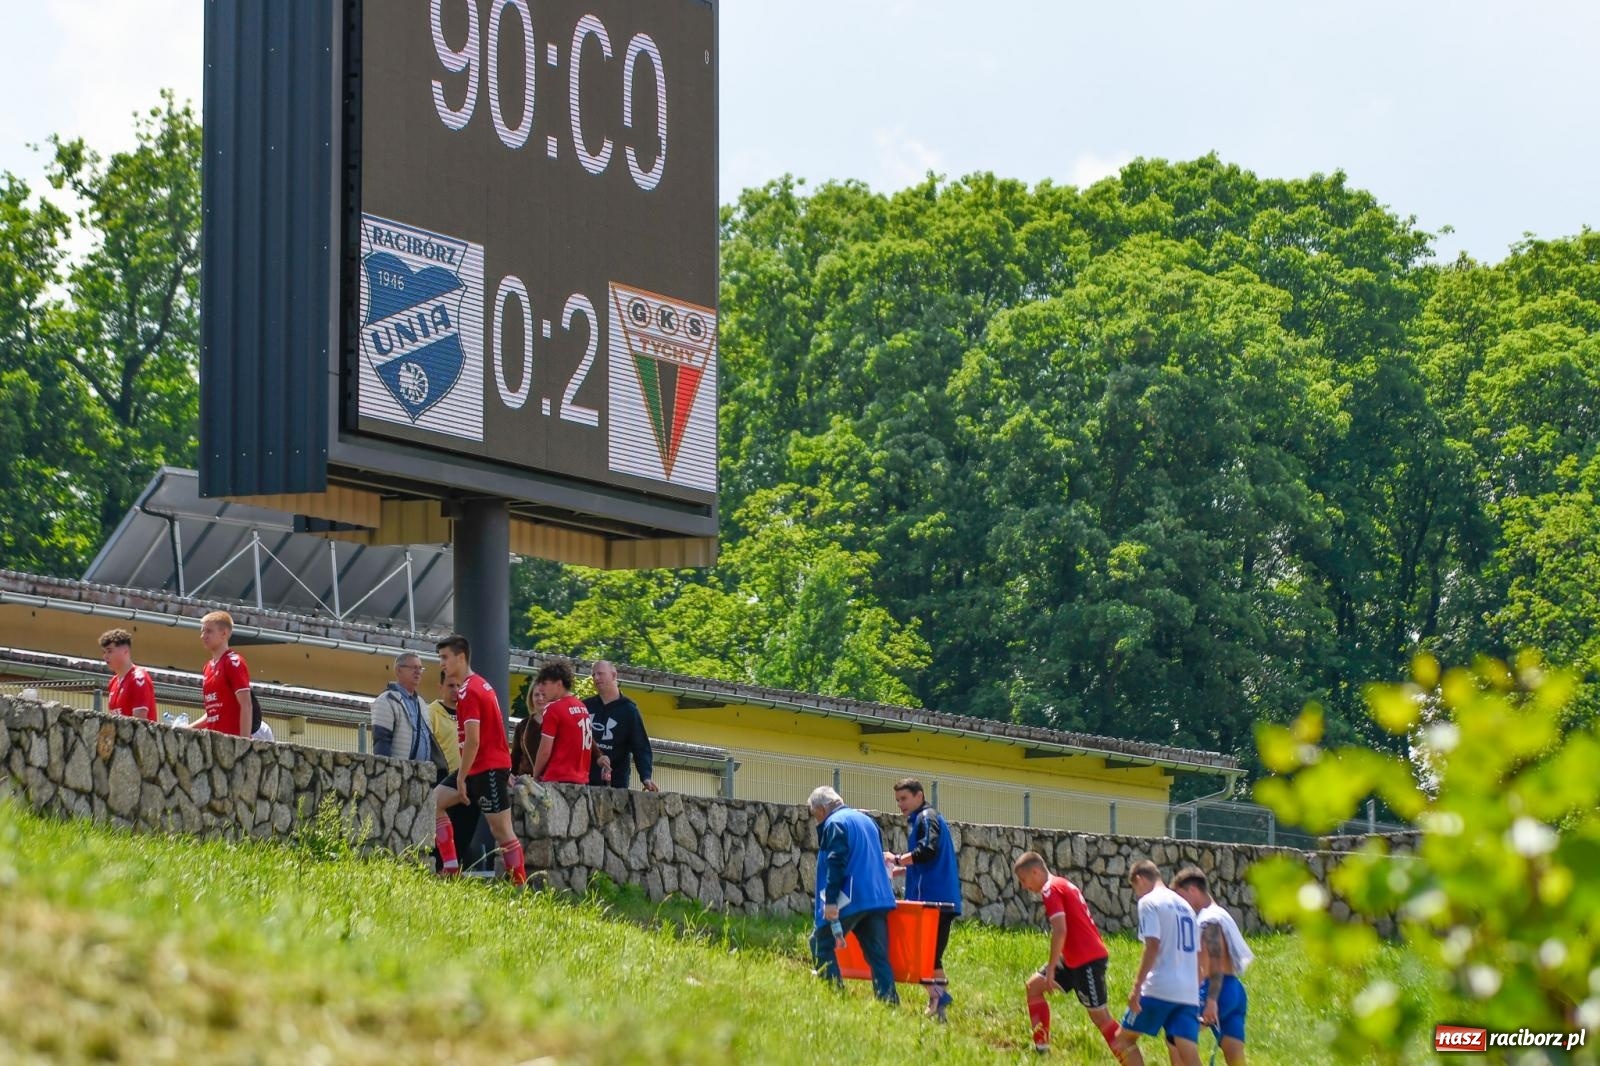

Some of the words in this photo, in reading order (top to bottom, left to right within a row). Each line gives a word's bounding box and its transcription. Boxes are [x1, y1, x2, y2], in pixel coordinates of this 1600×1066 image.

[372, 227, 457, 266] RACIBÓRZ
[377, 269, 405, 291] 1946
[371, 303, 451, 356] UNIA
[631, 302, 702, 335] GKS
[493, 275, 599, 427] 0:2
[638, 336, 696, 363] TYCHY
[577, 717, 593, 751] 18
[1176, 914, 1195, 952] 10
